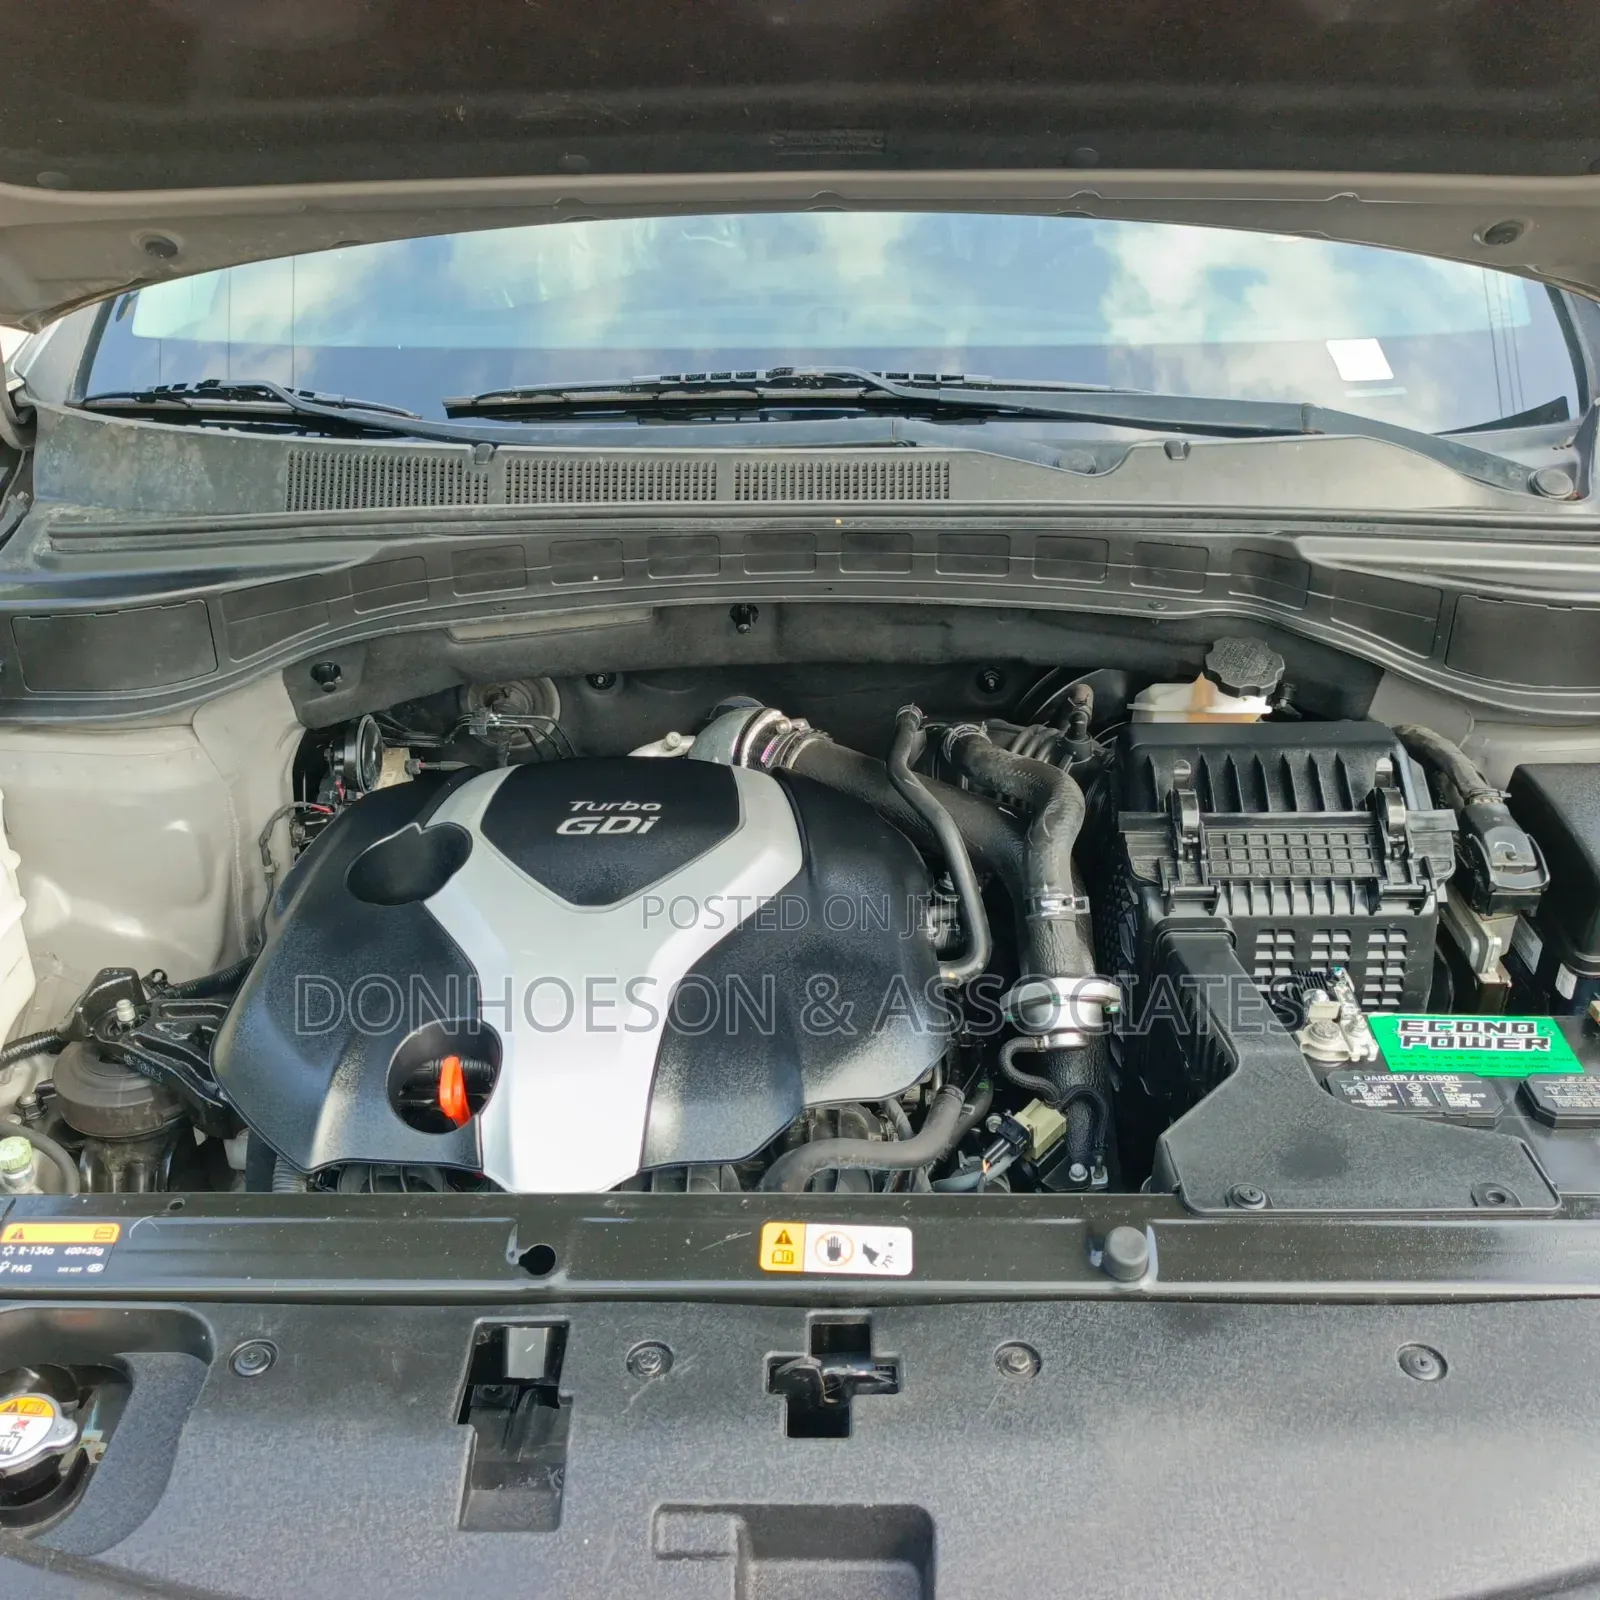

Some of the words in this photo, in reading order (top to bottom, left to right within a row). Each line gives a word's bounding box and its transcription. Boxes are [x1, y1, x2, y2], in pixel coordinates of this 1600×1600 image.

[570, 801, 662, 812] Turbo
[556, 816, 661, 835] GDi
[1398, 1019, 1538, 1035] ECONO
[1400, 1034, 1552, 1051] POWER
[10, 1264, 33, 1273] PAG
